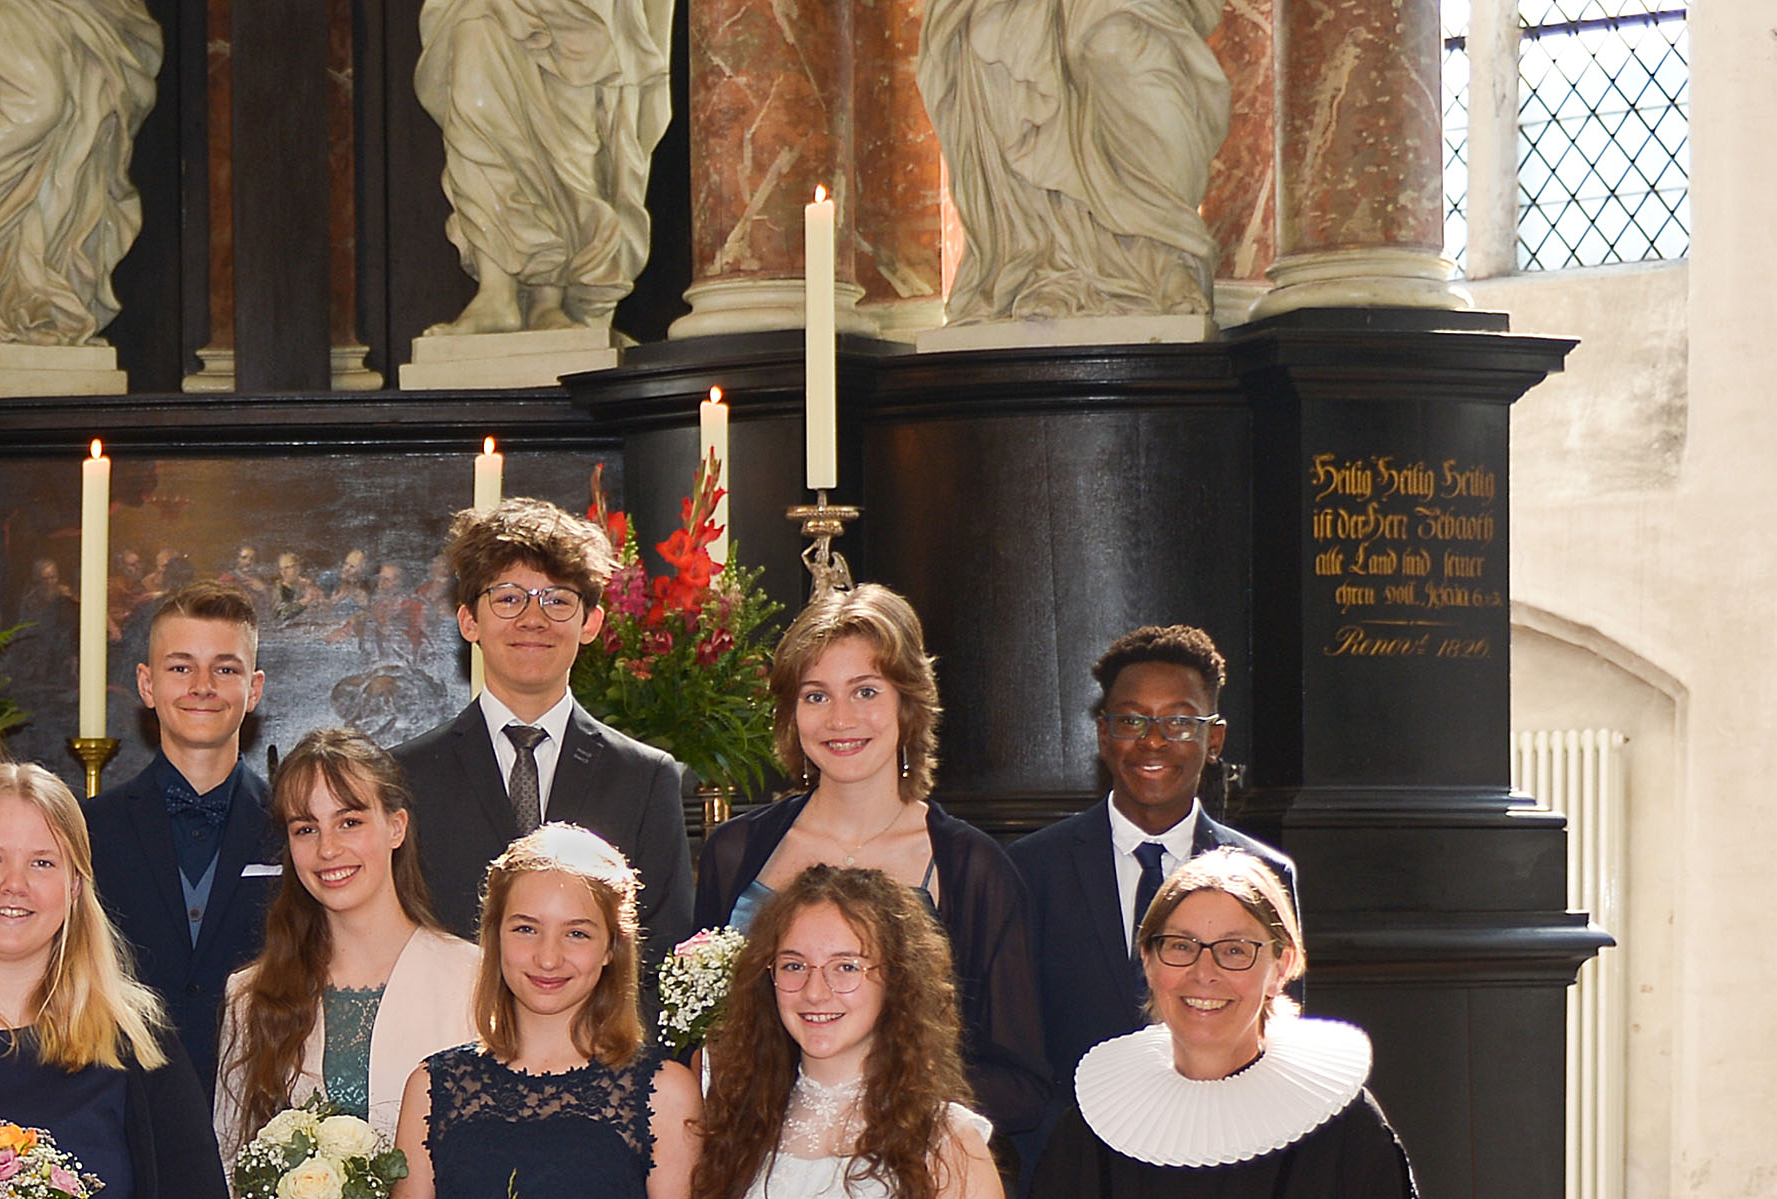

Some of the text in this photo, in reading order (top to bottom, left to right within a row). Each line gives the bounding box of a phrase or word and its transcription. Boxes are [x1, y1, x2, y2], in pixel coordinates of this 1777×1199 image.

[1310, 453, 1372, 502] Heilig
[1372, 456, 1435, 502] Heilig
[1313, 506, 1335, 542] ist
[1336, 507, 1365, 539] der
[1315, 545, 1345, 576] alle
[1348, 542, 1398, 576] Land
